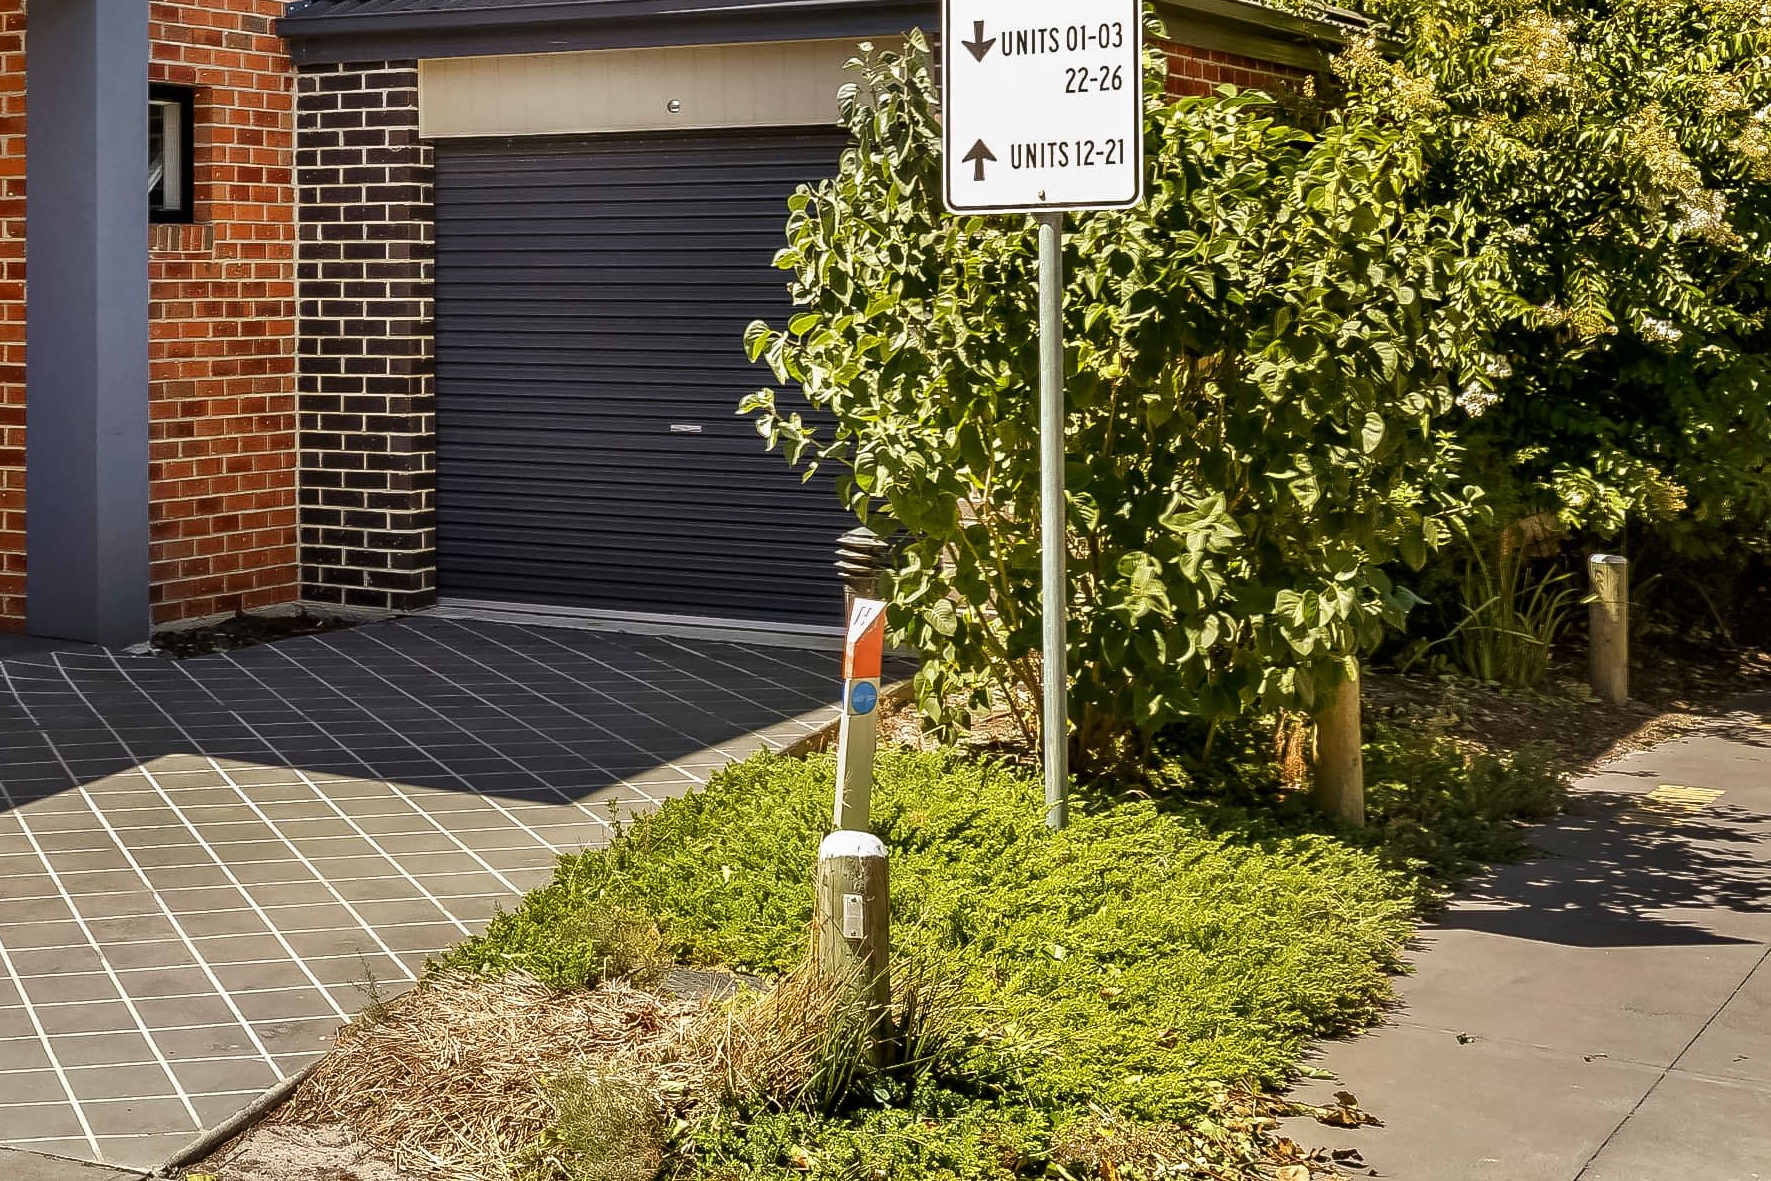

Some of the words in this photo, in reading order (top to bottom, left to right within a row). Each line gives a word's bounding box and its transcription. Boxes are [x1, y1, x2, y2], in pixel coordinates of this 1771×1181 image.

[1001, 27, 1060, 57] UNITS
[1066, 21, 1123, 52] 01-03
[1065, 64, 1123, 94] 22-26
[1010, 141, 1069, 170] UNITS
[1075, 138, 1124, 167] 12-21
